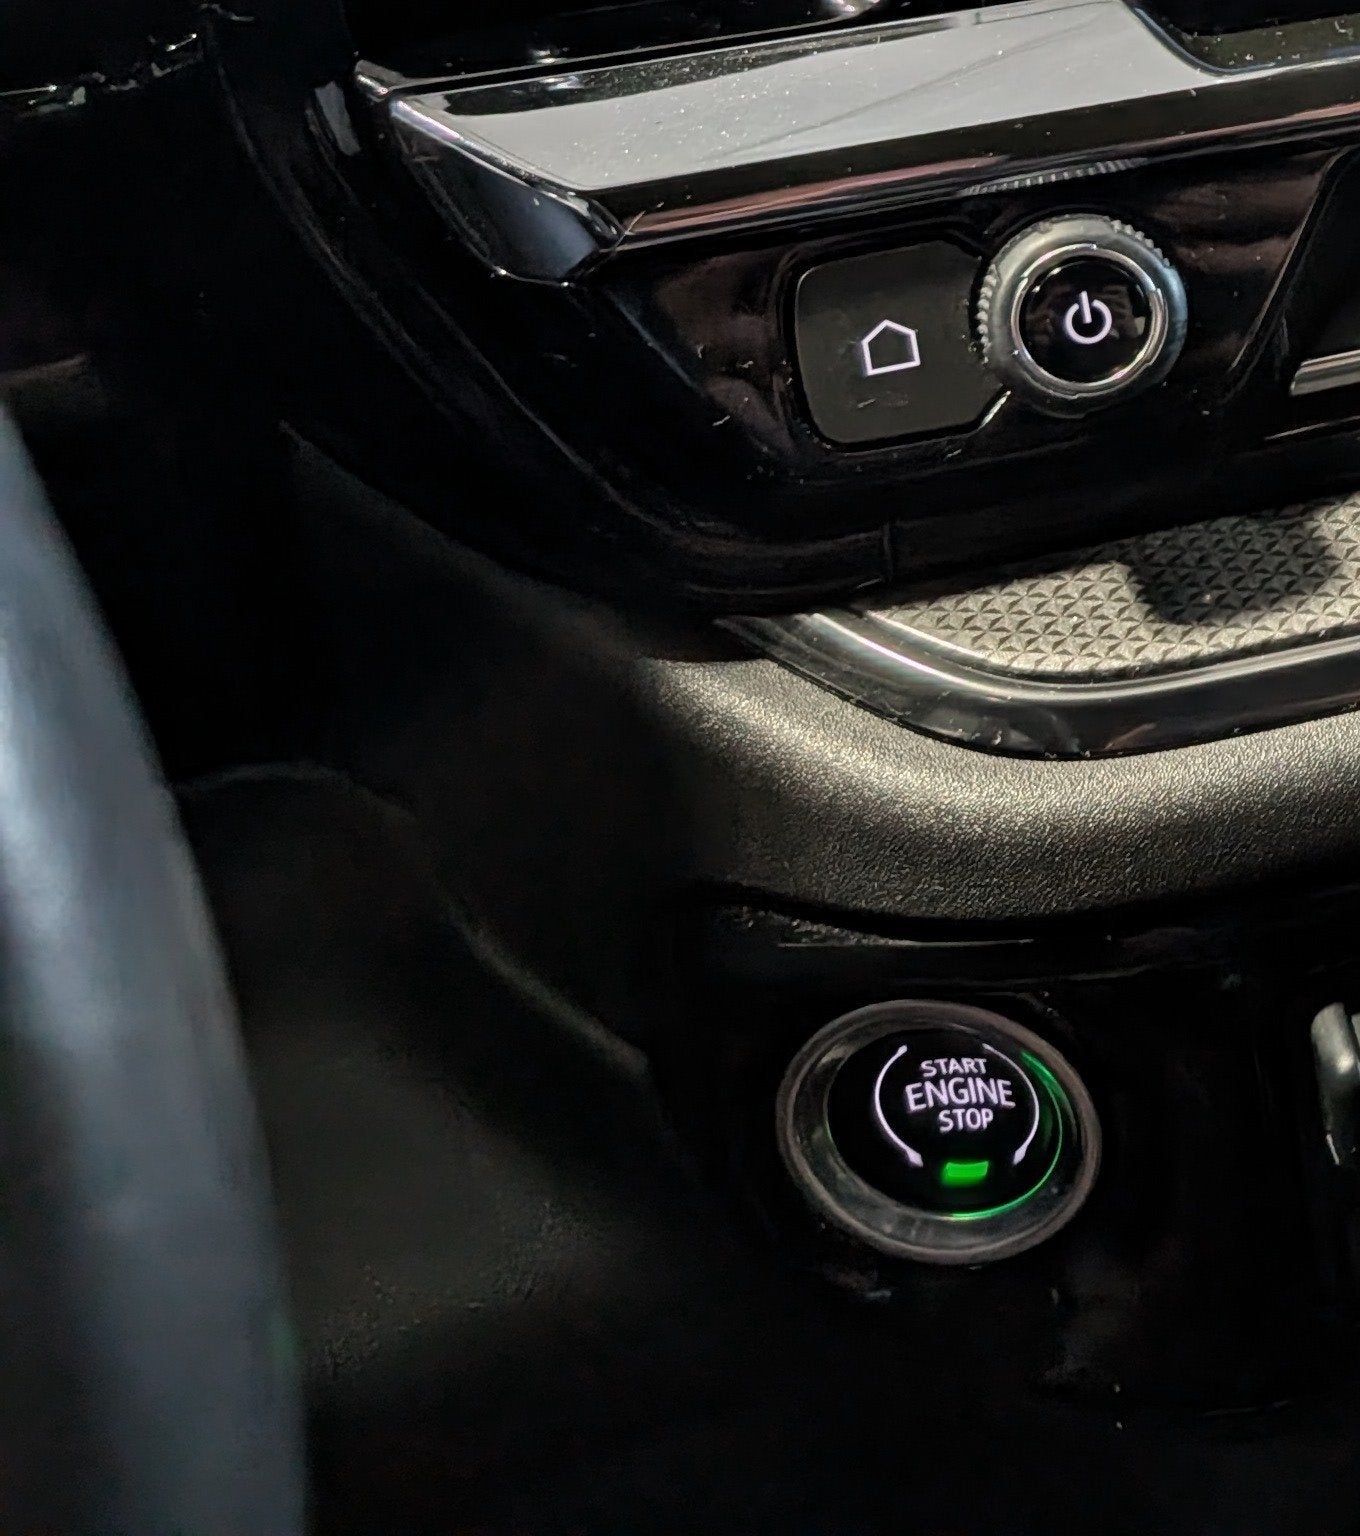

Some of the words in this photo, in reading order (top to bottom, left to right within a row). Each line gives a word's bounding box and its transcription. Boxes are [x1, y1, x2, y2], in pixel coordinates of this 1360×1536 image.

[921, 1057, 986, 1077] START
[904, 1077, 1015, 1113] ENGINE
[938, 1107, 994, 1133] STOP
